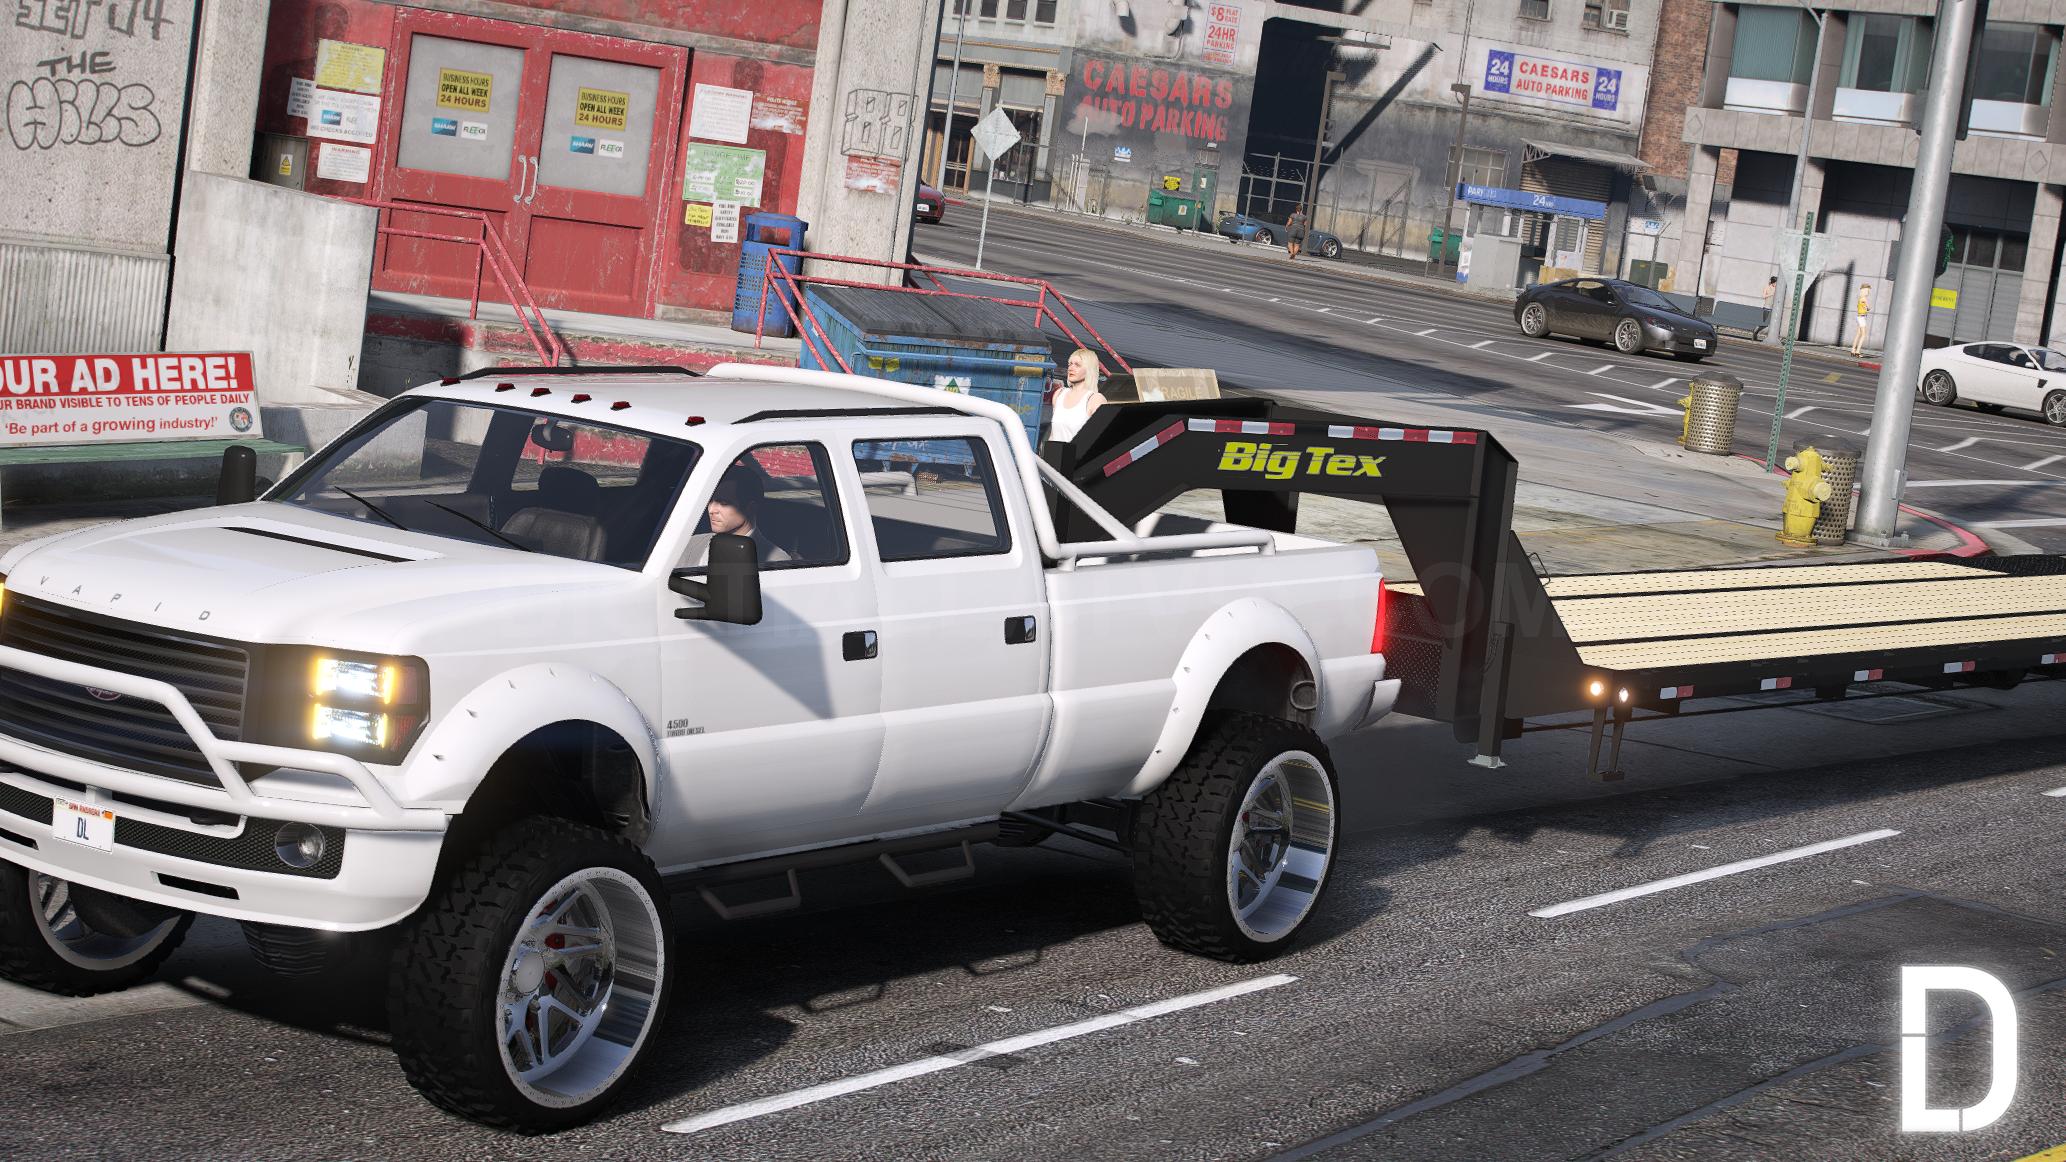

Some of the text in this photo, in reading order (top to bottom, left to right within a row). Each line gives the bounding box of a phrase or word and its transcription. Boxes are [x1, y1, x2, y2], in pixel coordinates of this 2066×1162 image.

[36, 50, 117, 77] THE
[1490, 59, 1510, 76] 24
[1487, 74, 1509, 84] HOURS
[1519, 60, 1590, 84] CAESARS
[441, 84, 488, 98] OPEN ALL WEEK
[1083, 59, 1233, 109] CAESARS
[1516, 78, 1588, 100] AUTO PARKING
[1598, 77, 1617, 93] 24
[440, 94, 487, 108] 24 HOURS
[1595, 92, 1616, 102] HOURS
[580, 102, 624, 116] OPEN ALL WEEK
[579, 113, 623, 126] 24 HOURS
[1139, 101, 1229, 142] PARKING
[70, 358, 121, 393] AD
[131, 356, 238, 391] HERE!
[16, 398, 56, 409] BRAND
[60, 397, 103, 408] VISIBLE
[105, 397, 121, 407] TO
[125, 395, 154, 407] TENS
[157, 395, 172, 406] OF
[175, 394, 217, 405] PEOPLE
[220, 393, 249, 404] DAILY
[1156, 386, 1202, 400] RAGILE
[31, 422, 59, 436] part
[62, 420, 76, 432] of
[80, 423, 88, 432] a
[92, 417, 155, 435] growing
[667, 718, 688, 729] 4500
[77, 816, 89, 840] DL
